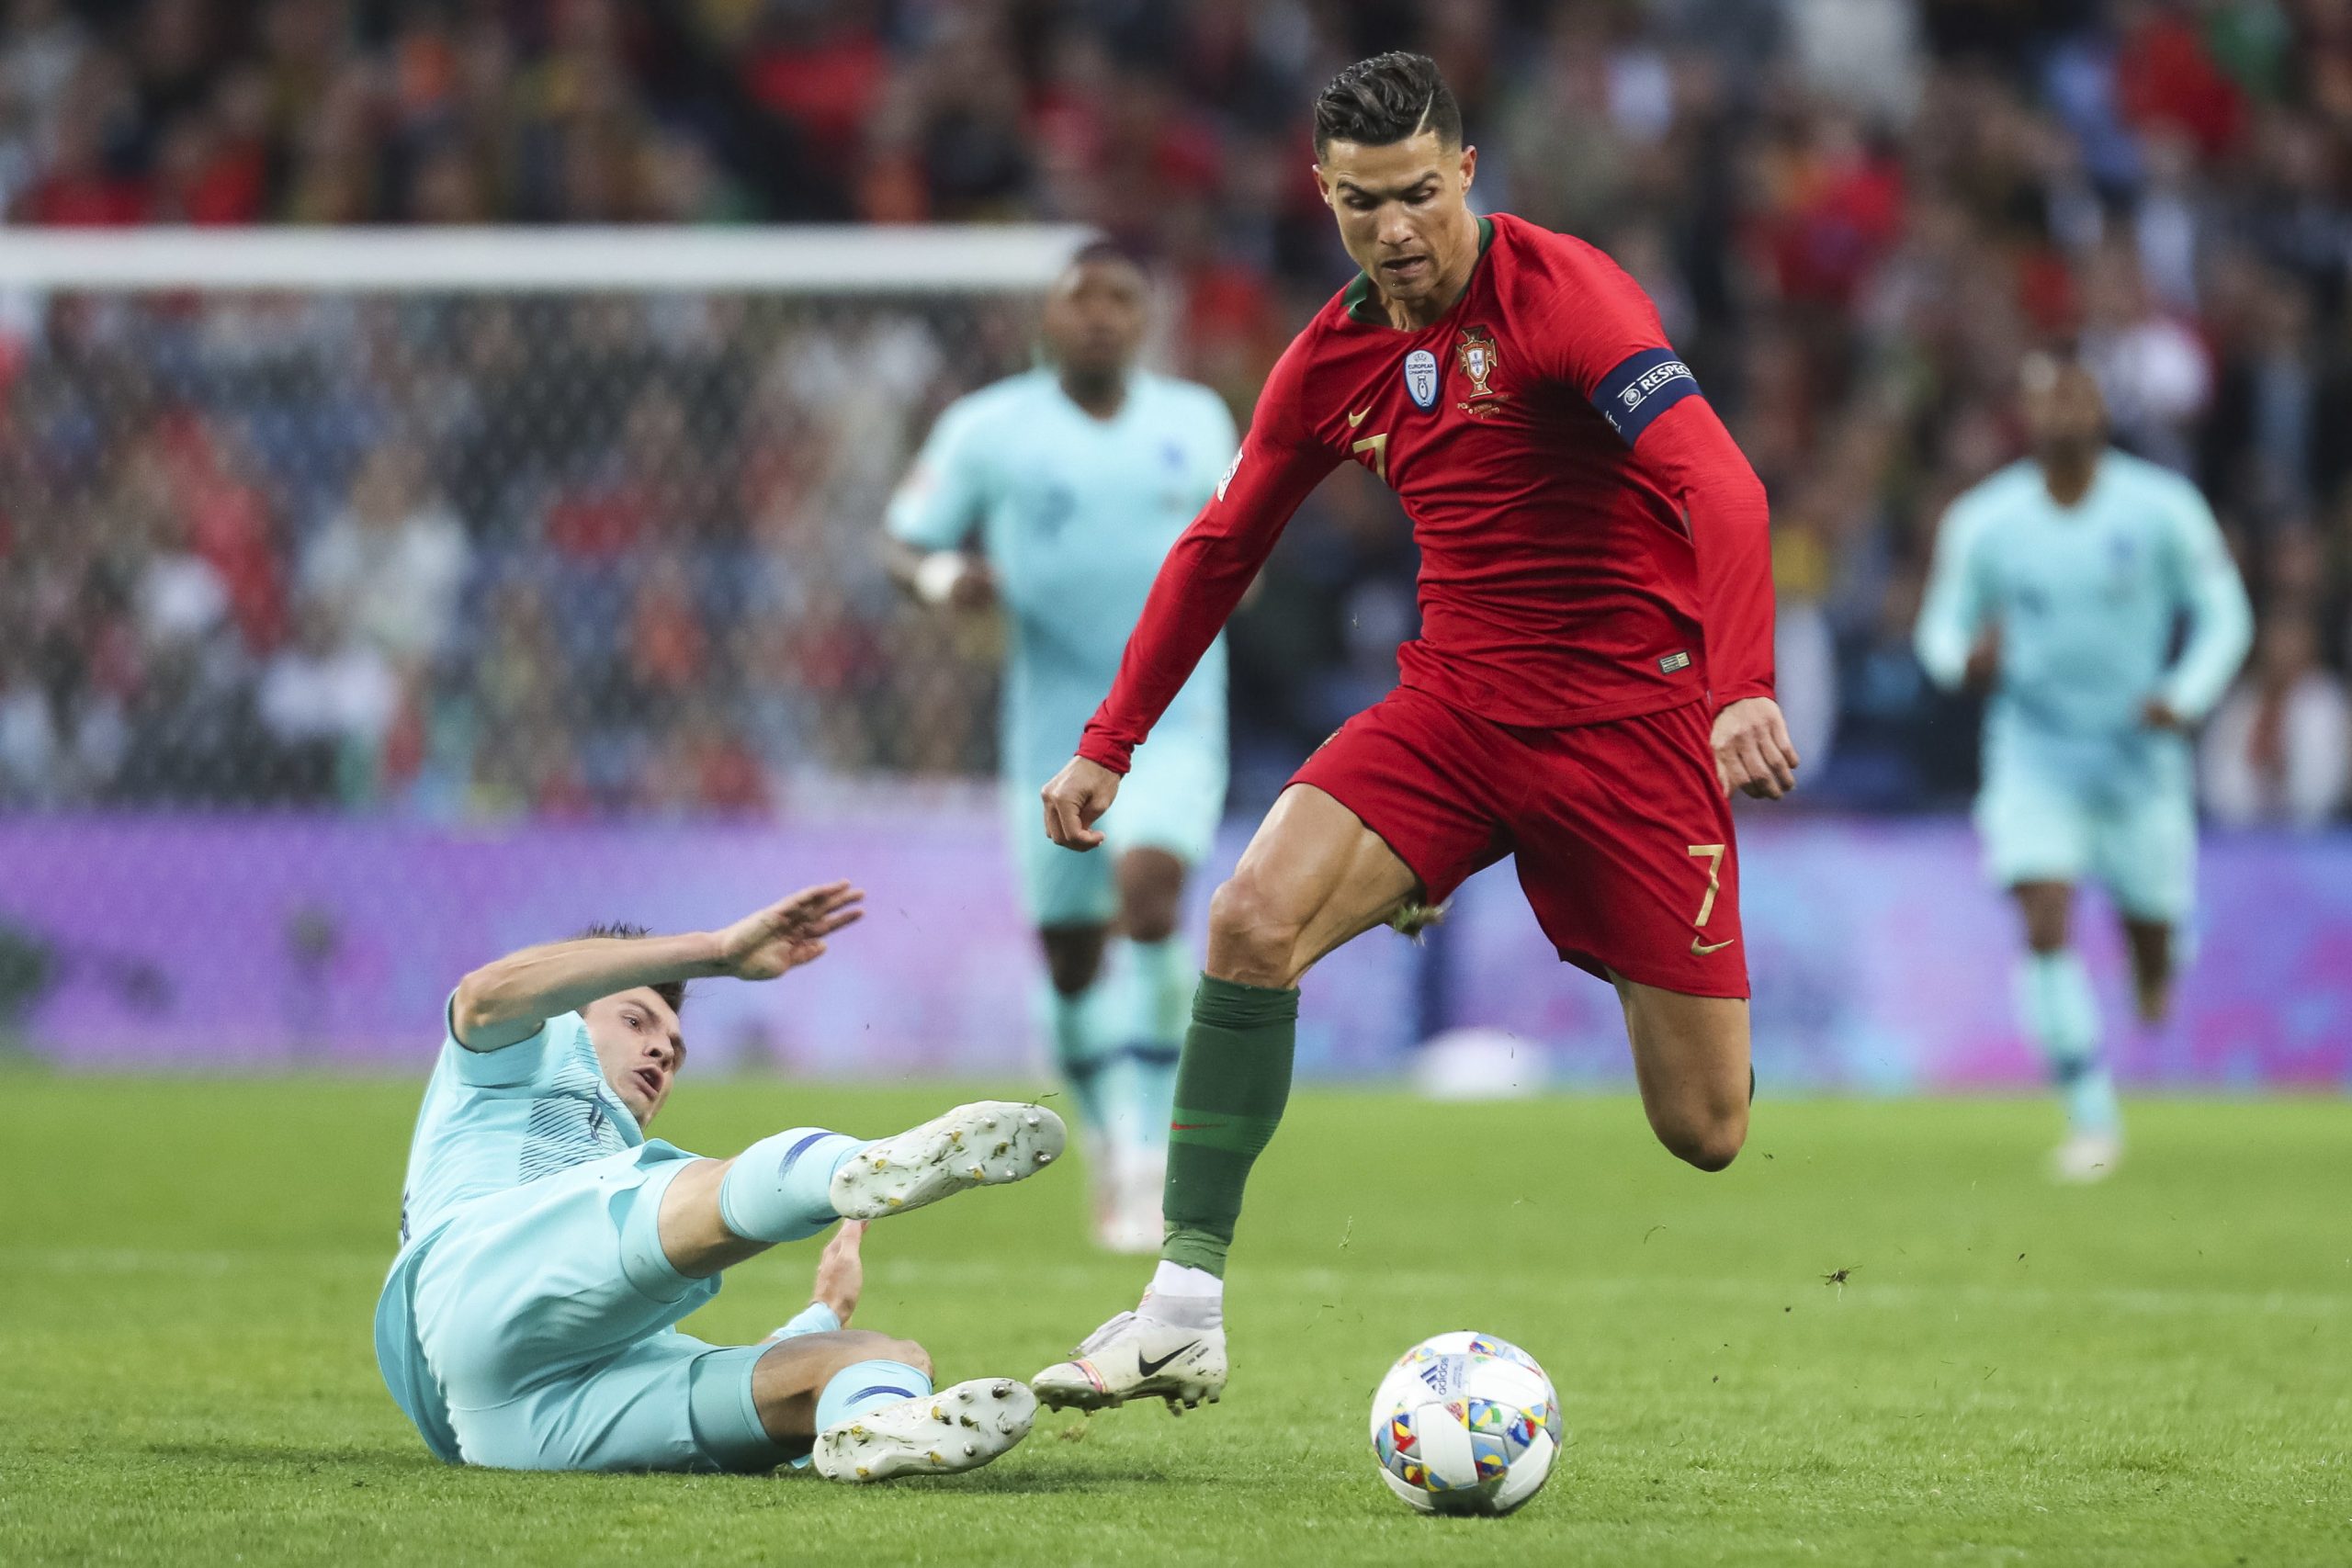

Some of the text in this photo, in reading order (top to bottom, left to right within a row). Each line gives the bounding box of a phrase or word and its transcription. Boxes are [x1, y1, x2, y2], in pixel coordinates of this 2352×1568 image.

[1351, 433, 1388, 485] 7
[1688, 844, 1725, 927] 7
[1438, 1357, 1450, 1395] adidas
